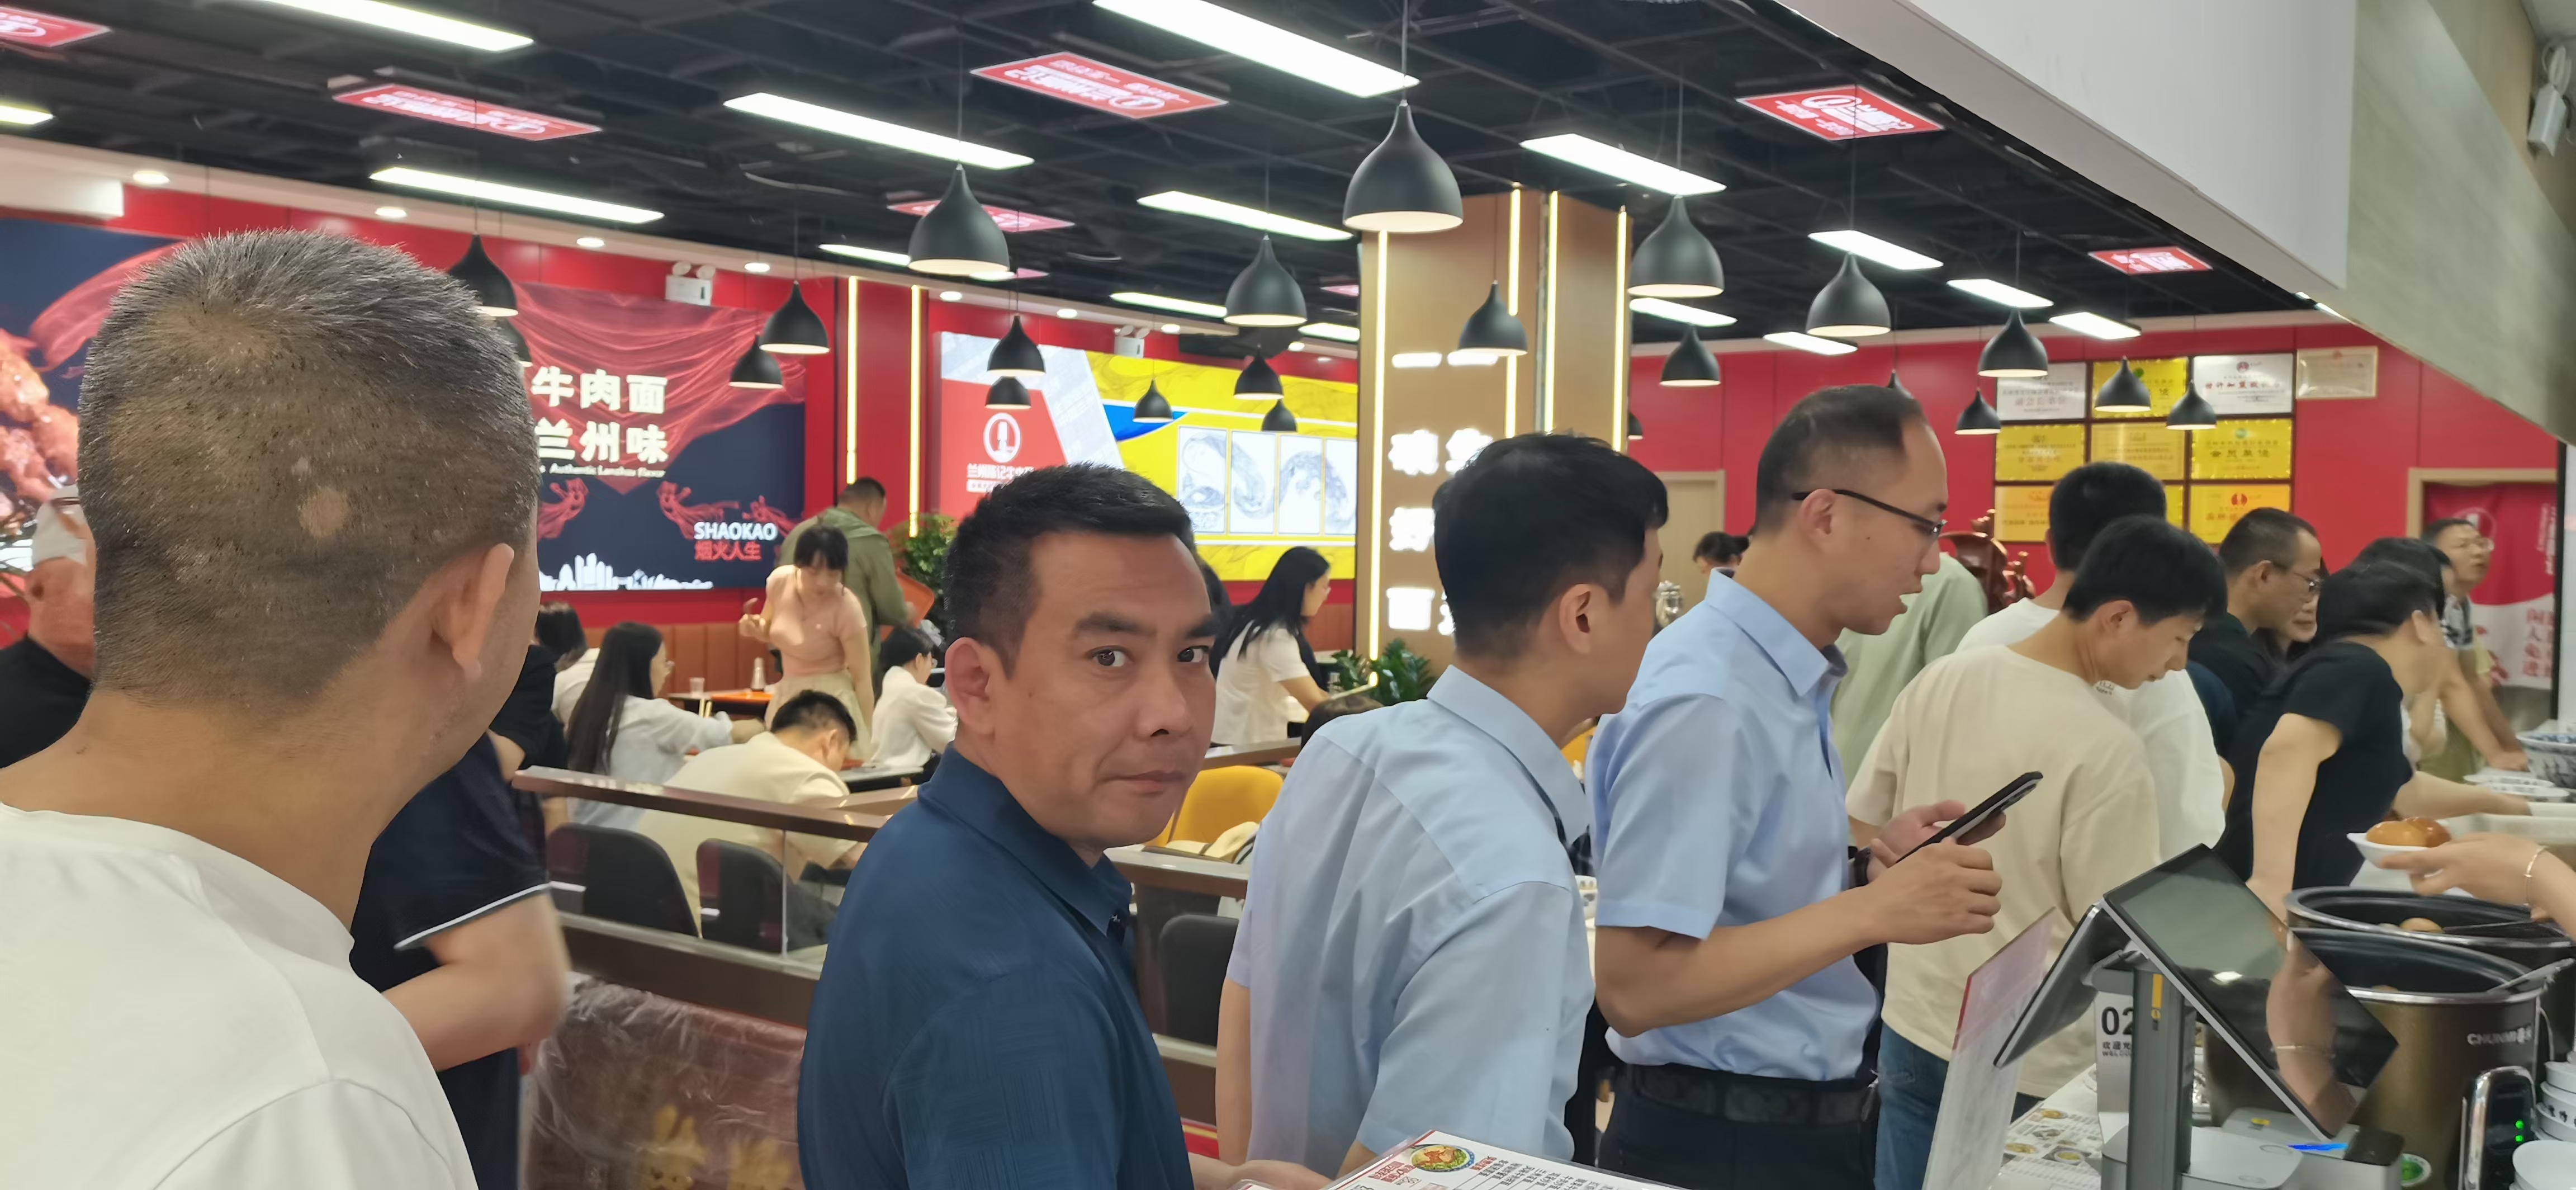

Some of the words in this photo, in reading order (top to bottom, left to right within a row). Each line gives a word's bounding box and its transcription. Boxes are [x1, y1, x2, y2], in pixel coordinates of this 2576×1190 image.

[531, 366, 668, 414] 牛肉面
[534, 417, 669, 464] 兰州味
[694, 521, 778, 541] SHAOKAO
[694, 540, 762, 561] 烟火人生
